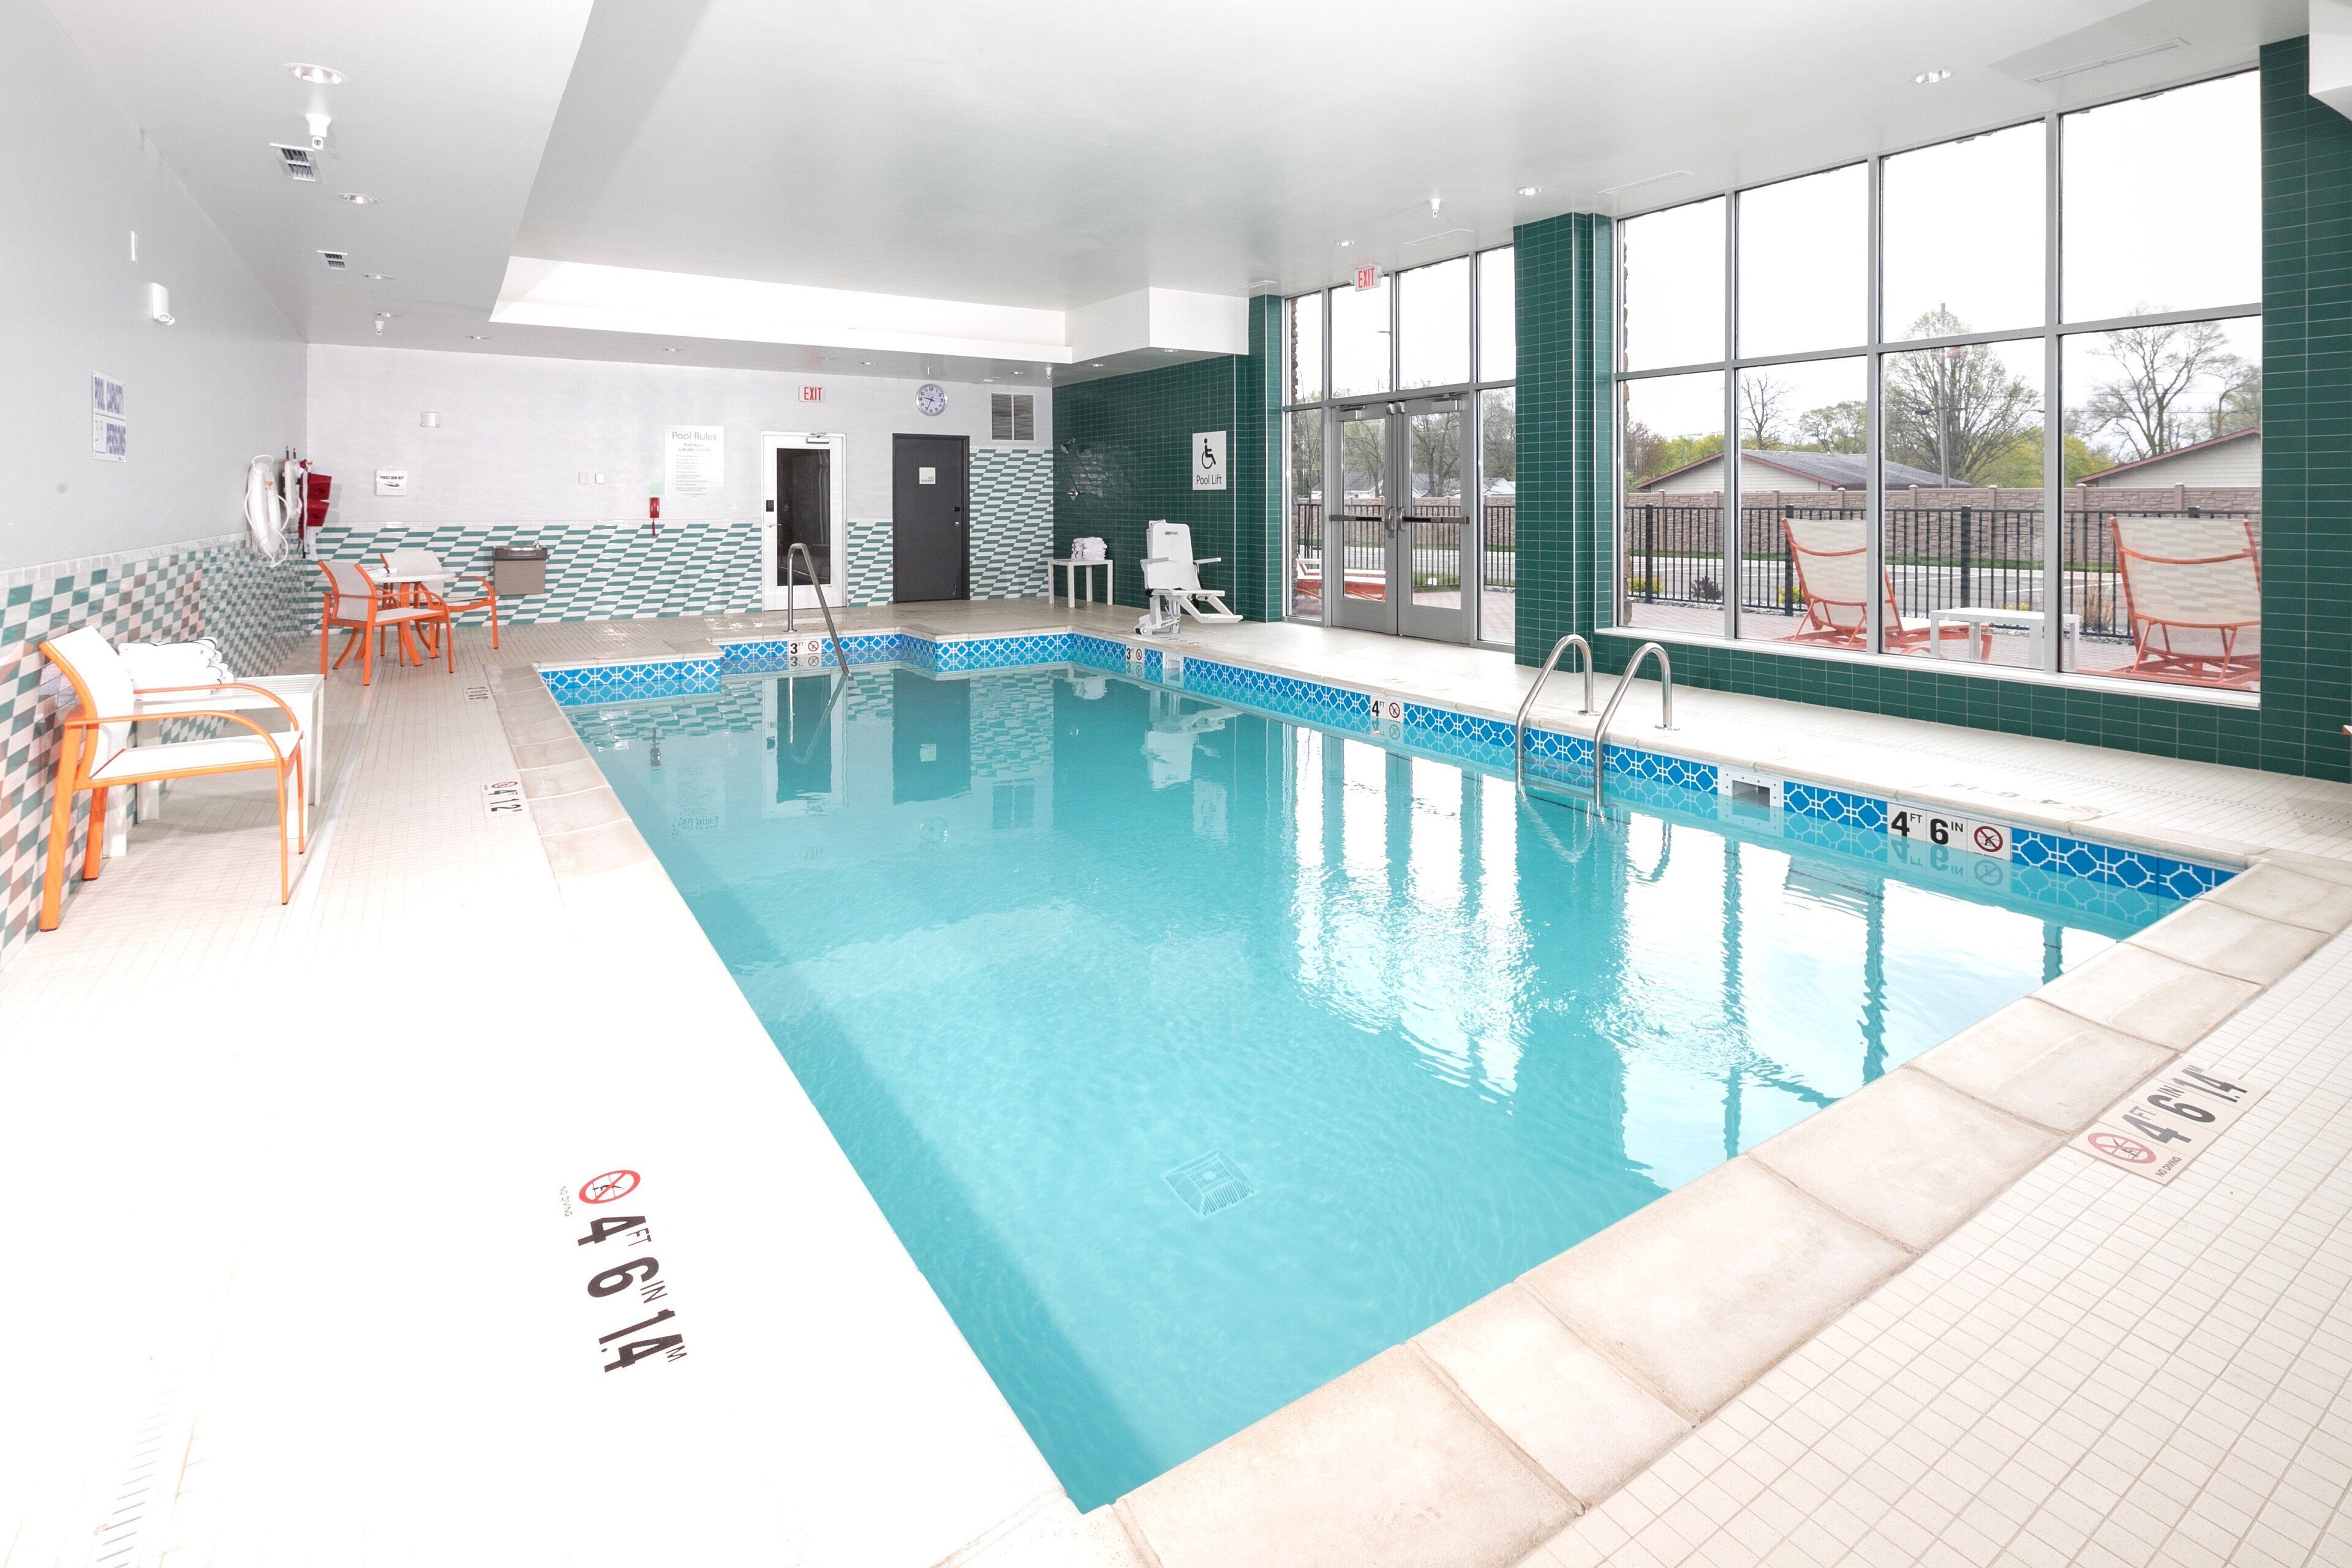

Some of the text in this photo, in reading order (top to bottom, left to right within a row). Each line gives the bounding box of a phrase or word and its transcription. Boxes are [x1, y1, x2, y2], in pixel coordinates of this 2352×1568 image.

[1358, 267, 1375, 288] EXIT
[804, 386, 822, 401] EXIT
[672, 431, 717, 440] Pool Rules
[1196, 473, 1223, 485] Pool Lift
[790, 643, 798, 655] 3
[1126, 648, 1131, 660] 3
[1371, 700, 1380, 717] 4
[1891, 811, 1964, 845] 4 FT 6 IN
[2157, 1085, 2185, 1098] IN
[2171, 1068, 2248, 1103] 1.4
[2128, 1105, 2156, 1120] FT
[2147, 1094, 2216, 1123] 6
[2121, 1114, 2192, 1144] 4
[2155, 1156, 2182, 1177] NO DIVING
[561, 1196, 573, 1217] DIVING
[578, 1215, 688, 1373] 4 FT 6 IN 1.4 M
